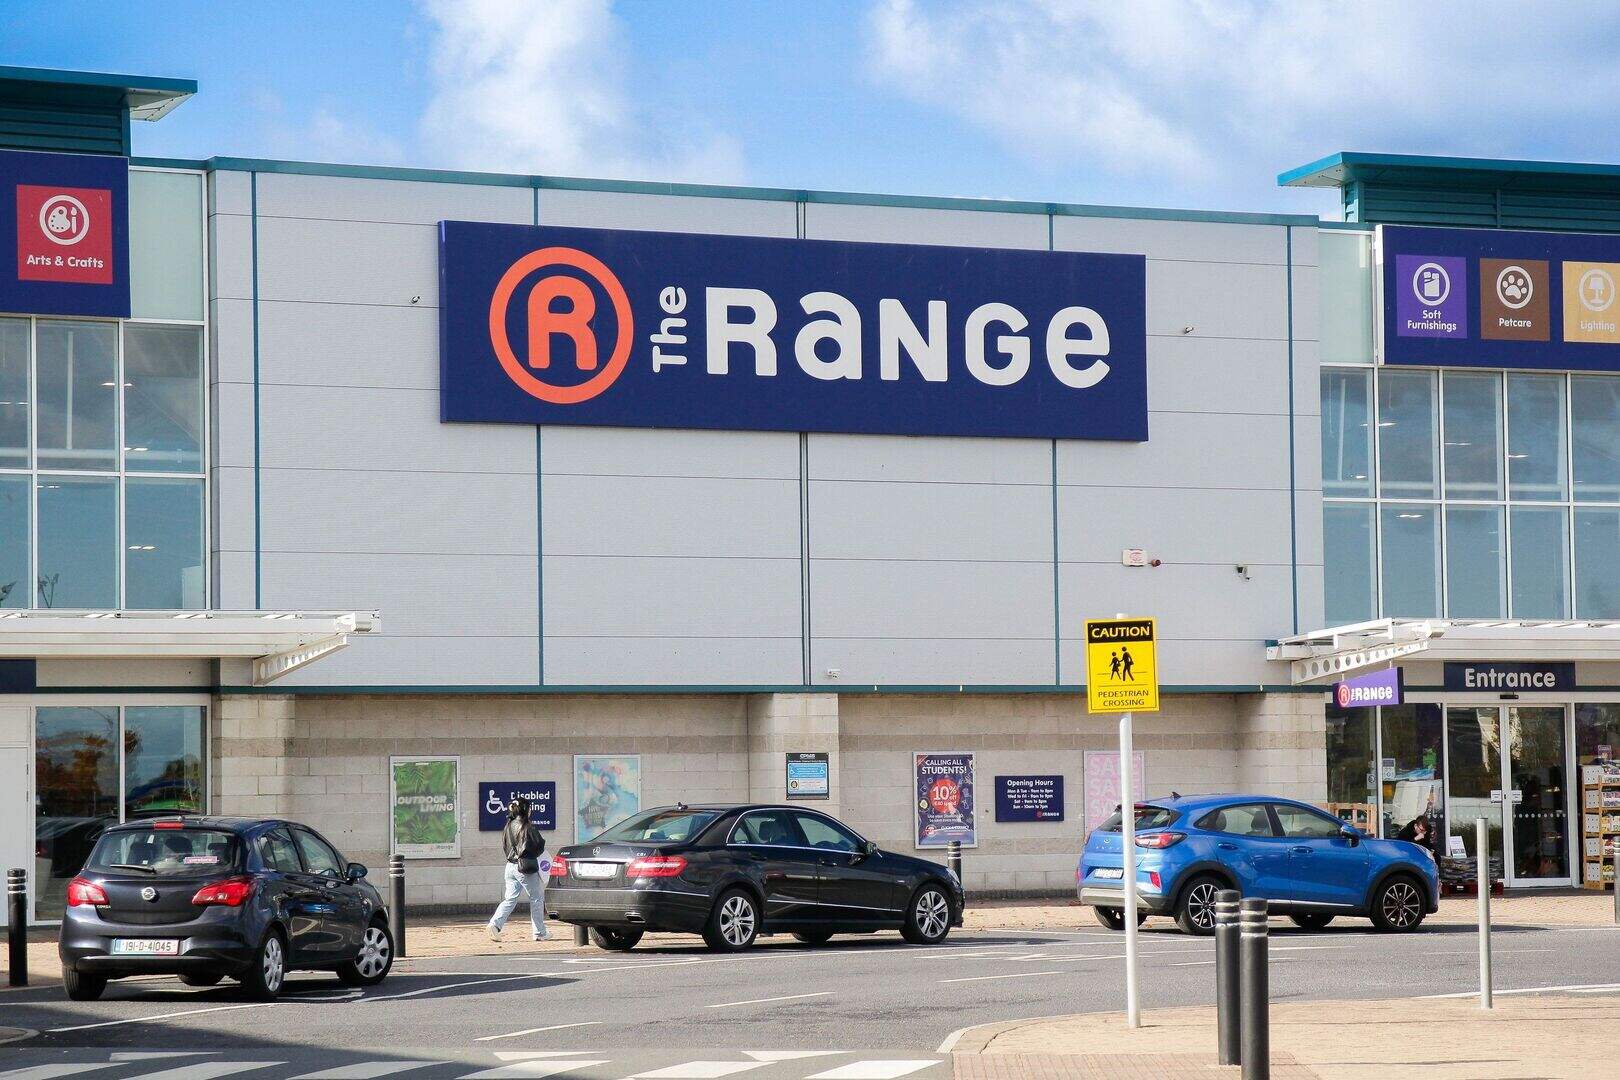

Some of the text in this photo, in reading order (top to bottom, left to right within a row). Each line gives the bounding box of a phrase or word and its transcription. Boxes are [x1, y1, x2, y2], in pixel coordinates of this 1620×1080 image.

[27, 255, 104, 268] Arts & Crafts
[1422, 310, 1441, 319] Soft
[1408, 320, 1456, 332] Furnishings
[1499, 318, 1532, 328] Petcare
[1580, 320, 1616, 332] Lighting
[650, 286, 687, 373] The
[1092, 626, 1150, 638] CAUTION
[1466, 668, 1556, 688] Entrance
[1098, 690, 1148, 698] PEDESTRIAN
[922, 766, 967, 774] STUDENTS!
[398, 796, 447, 804] OUTDOOR
[420, 804, 454, 812] LIVING
